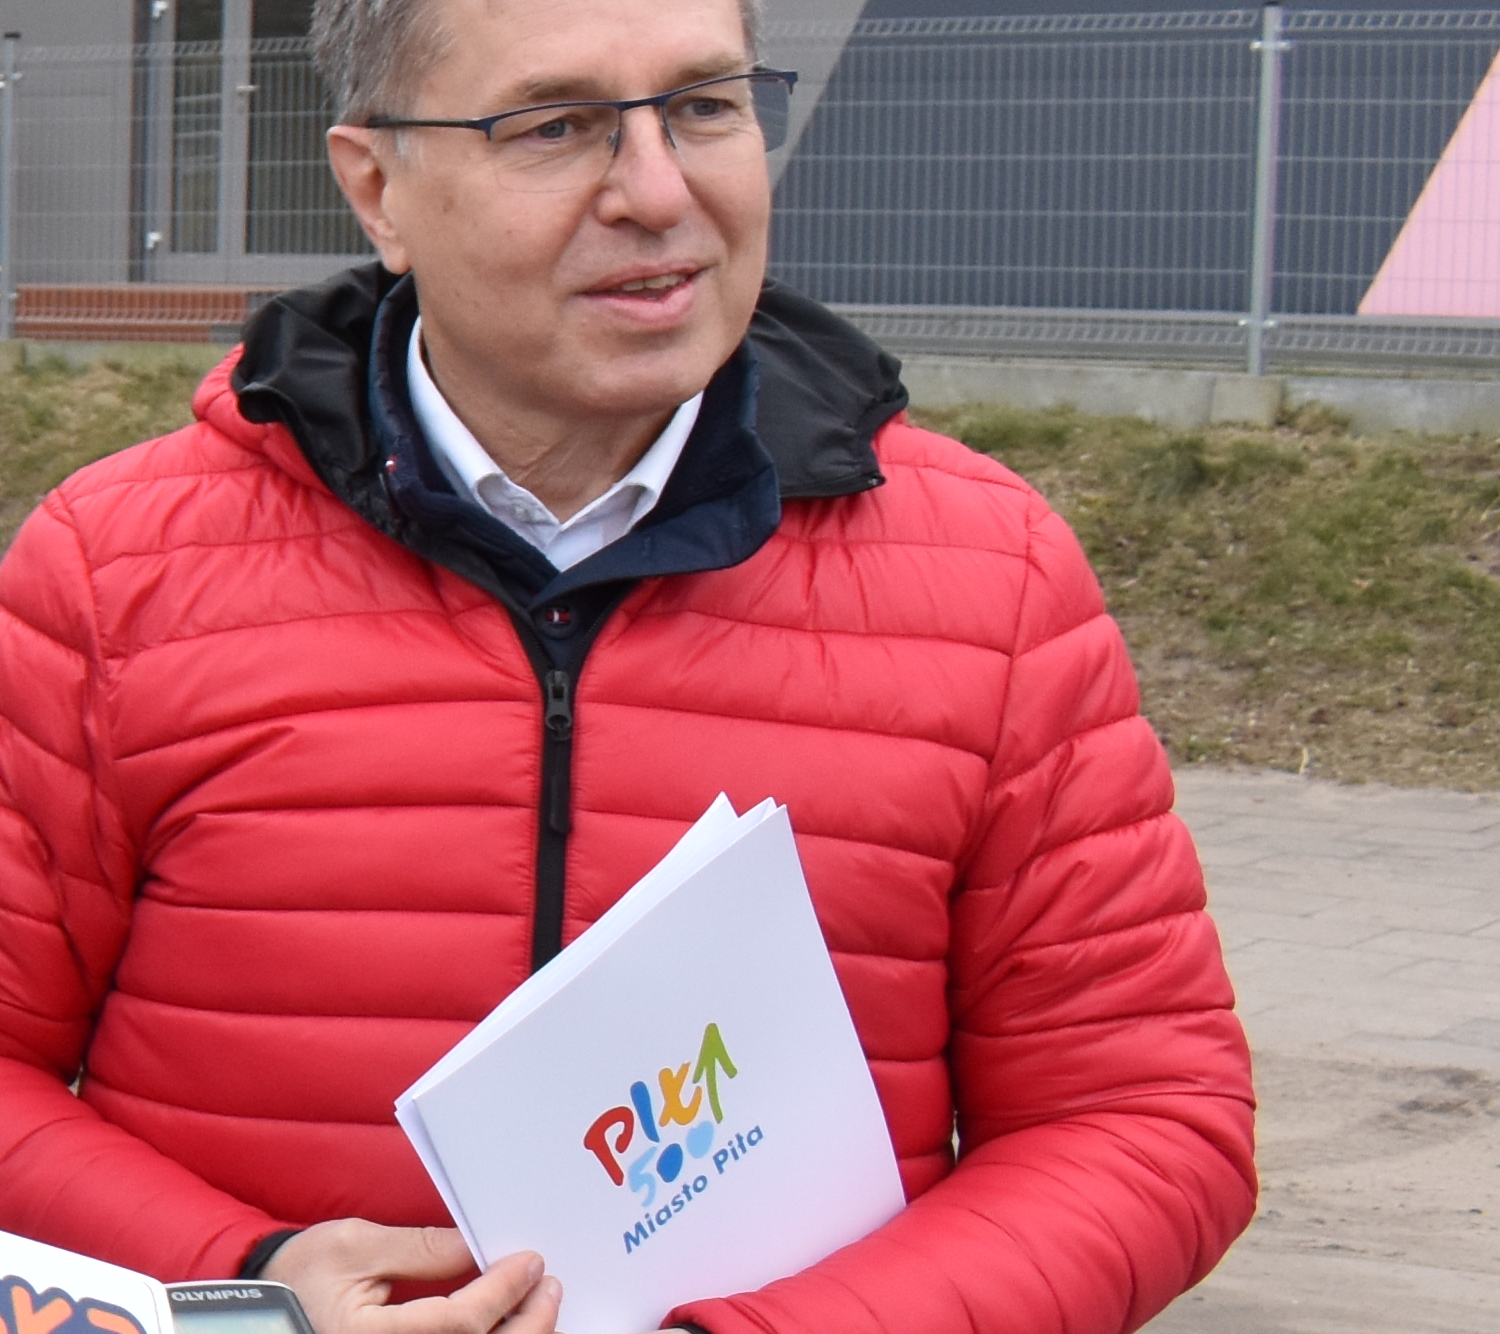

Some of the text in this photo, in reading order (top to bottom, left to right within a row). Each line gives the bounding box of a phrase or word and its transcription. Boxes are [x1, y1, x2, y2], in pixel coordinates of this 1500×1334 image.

[622, 1124, 765, 1255] Miasto Piła
[171, 1288, 263, 1302] OLYMPUS
